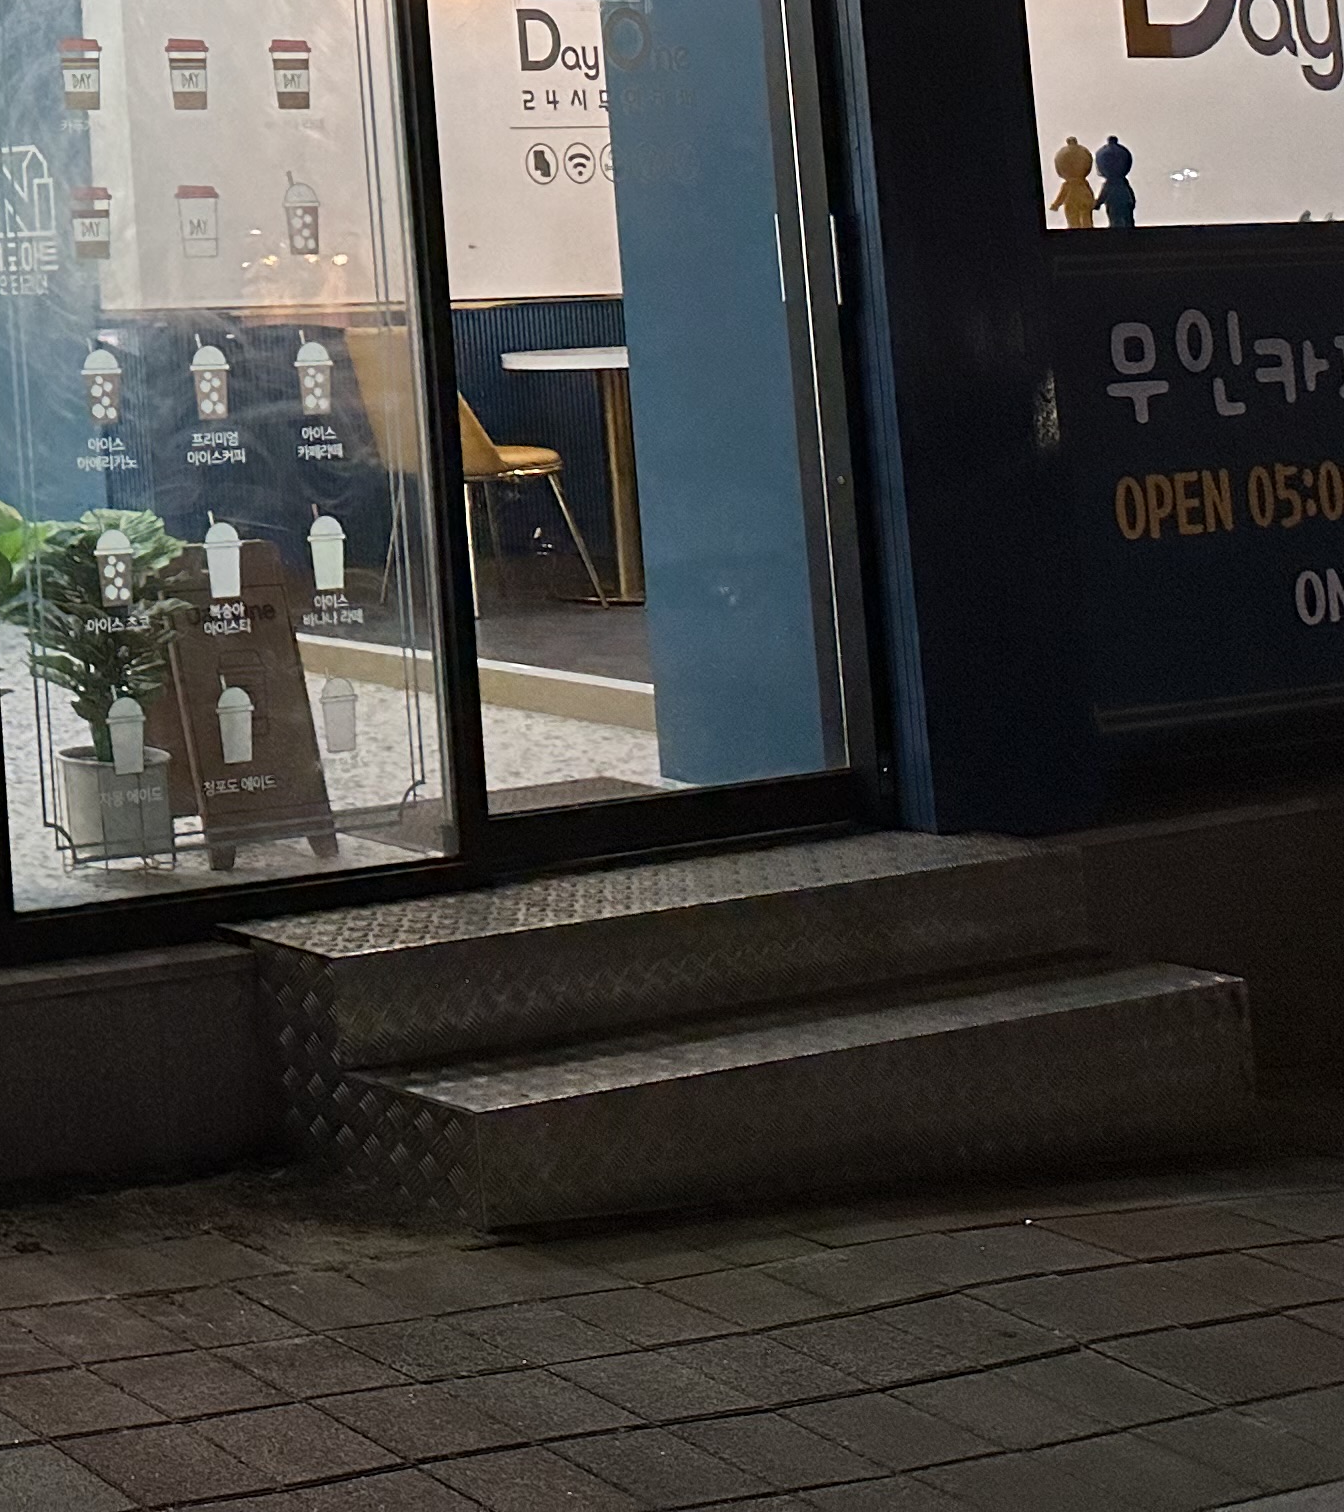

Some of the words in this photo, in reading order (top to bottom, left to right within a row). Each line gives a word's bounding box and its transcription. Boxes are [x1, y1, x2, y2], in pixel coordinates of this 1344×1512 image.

[515, 8, 601, 80] Day
[1106, 308, 1344, 425] 무인카
[191, 431, 240, 448] 프리미엄
[301, 425, 338, 441] 아이스
[88, 437, 126, 454] 아이스
[187, 449, 247, 466] 아이스커피
[1115, 466, 1234, 541] OPEN
[314, 593, 349, 610] 아이스
[86, 616, 126, 635] 아이스
[203, 619, 252, 636] 아이스티
